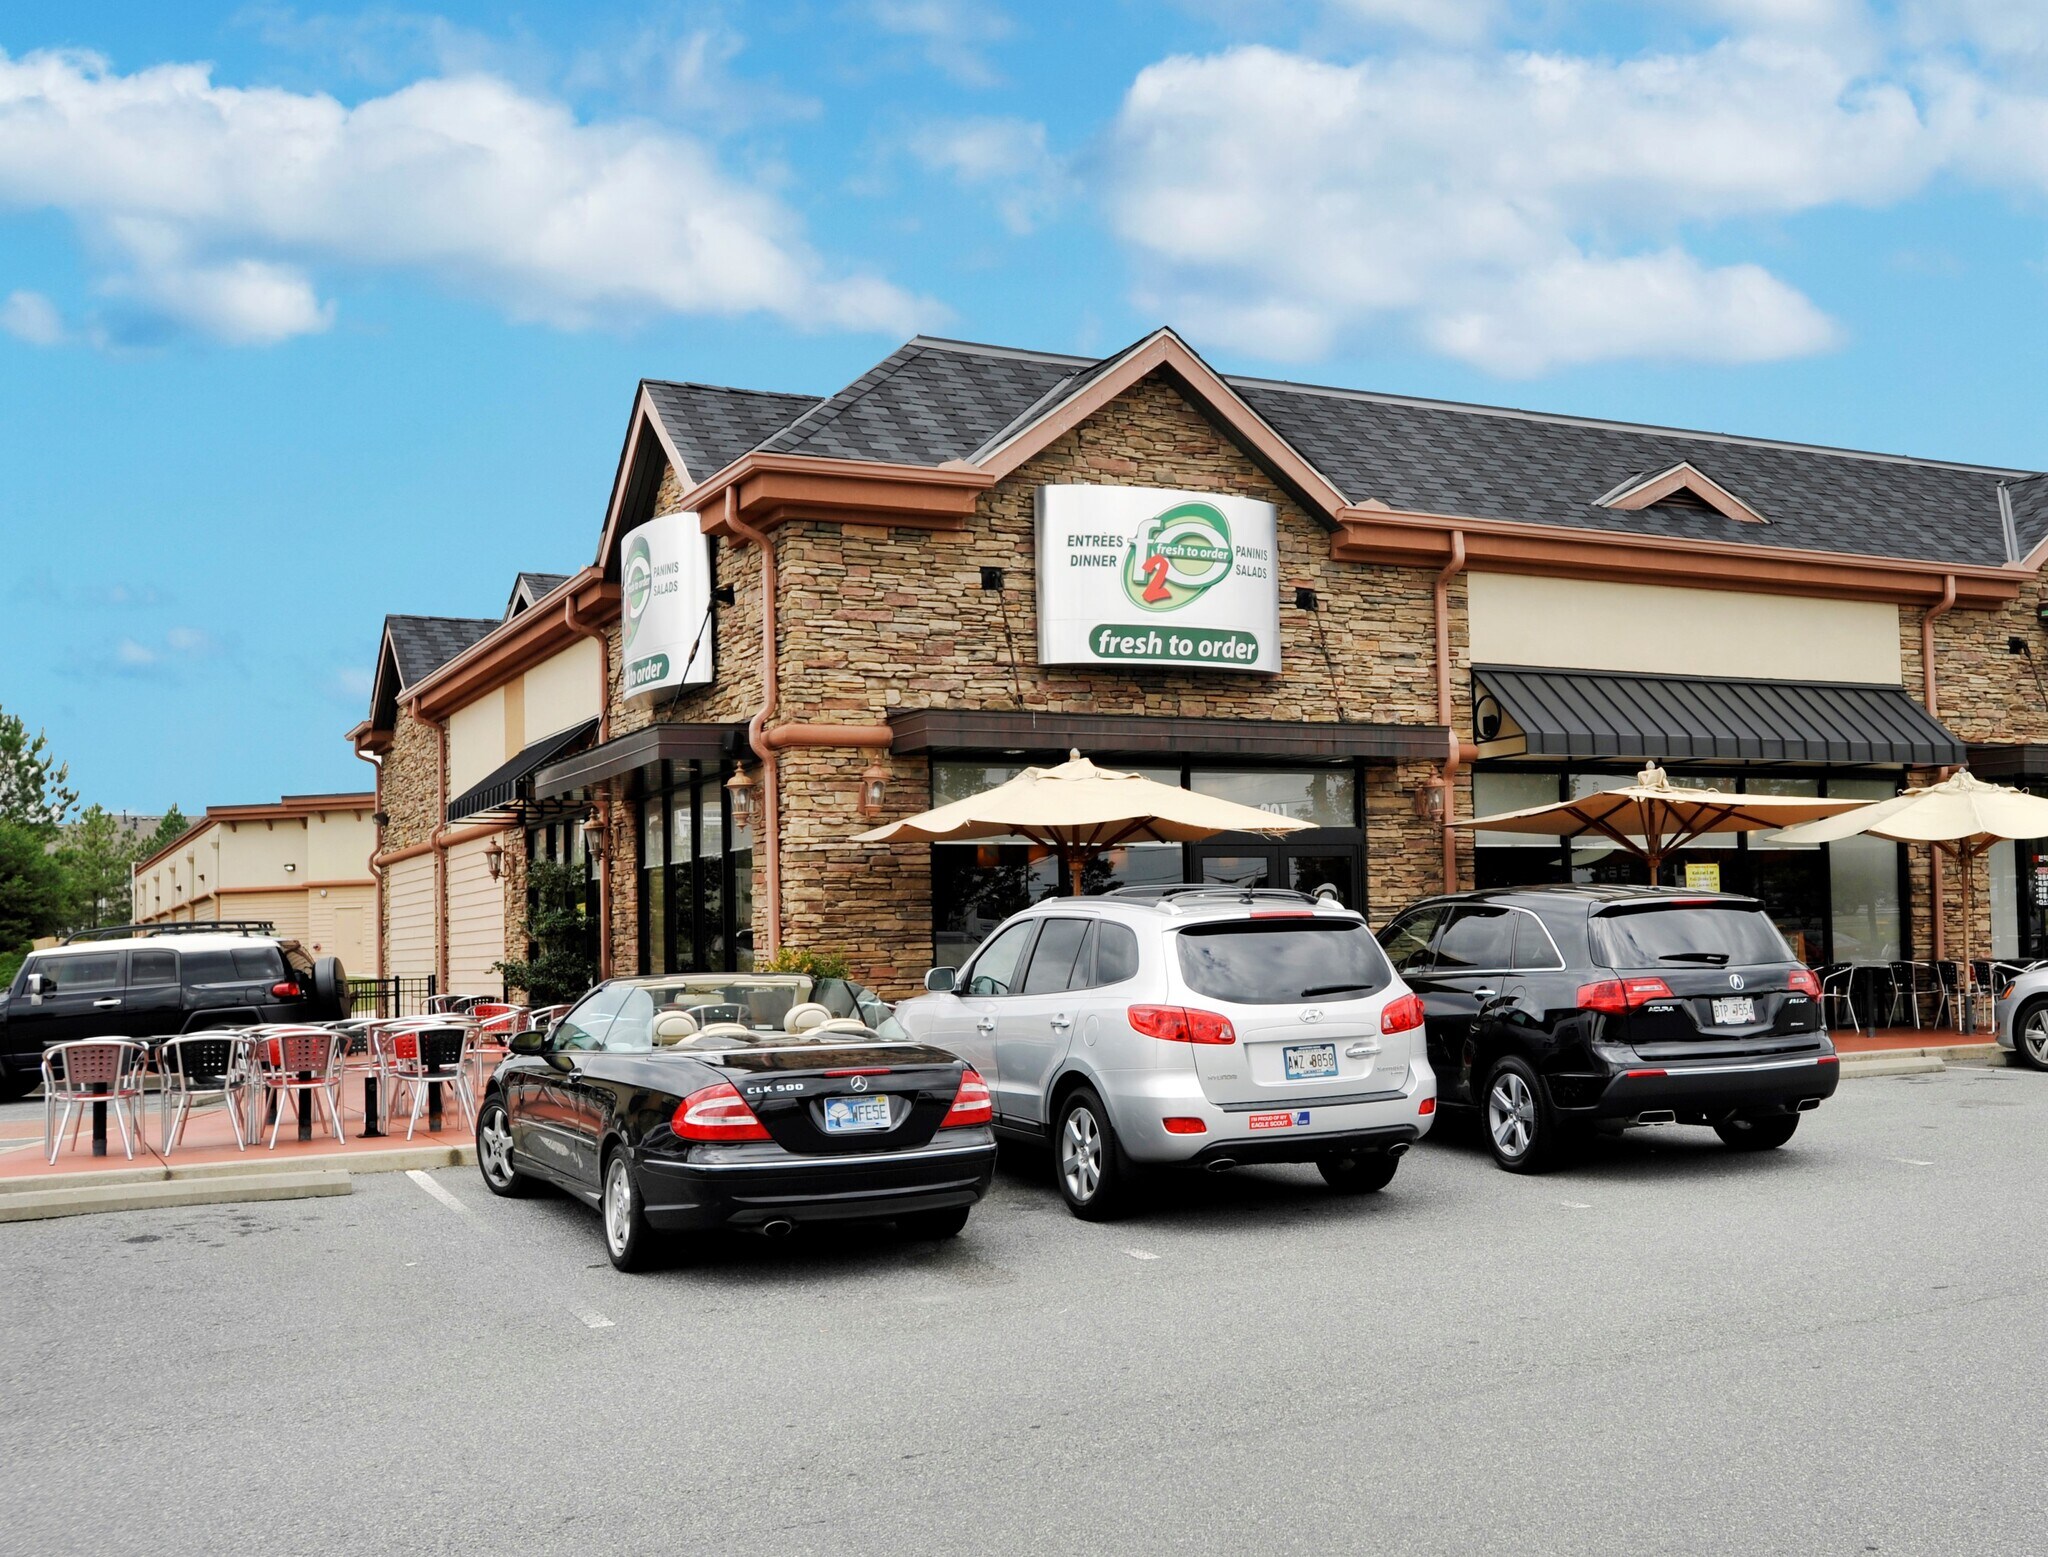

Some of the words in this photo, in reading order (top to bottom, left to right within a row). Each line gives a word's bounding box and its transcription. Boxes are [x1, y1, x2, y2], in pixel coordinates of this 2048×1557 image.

[1156, 543, 1185, 556] fresh
[1187, 546, 1199, 557] to
[1200, 548, 1229, 560] order
[1236, 545, 1268, 561] PANINIS
[1070, 554, 1117, 567] DINNER
[653, 561, 679, 578] PANINIS
[1236, 564, 1267, 579] SALADS
[653, 580, 679, 597] SALADS
[1098, 629, 1163, 655] fresh
[1168, 634, 1194, 656] to
[1198, 635, 1256, 660] order
[636, 659, 663, 684] order
[1288, 1054, 1305, 1069] AWZ
[1311, 1052, 1334, 1068] 8858
[747, 1085, 773, 1095] CLK
[776, 1083, 804, 1093] 500
[1250, 1120, 1269, 1128] EAGLE
[1269, 1119, 1288, 1127] SCOUT
